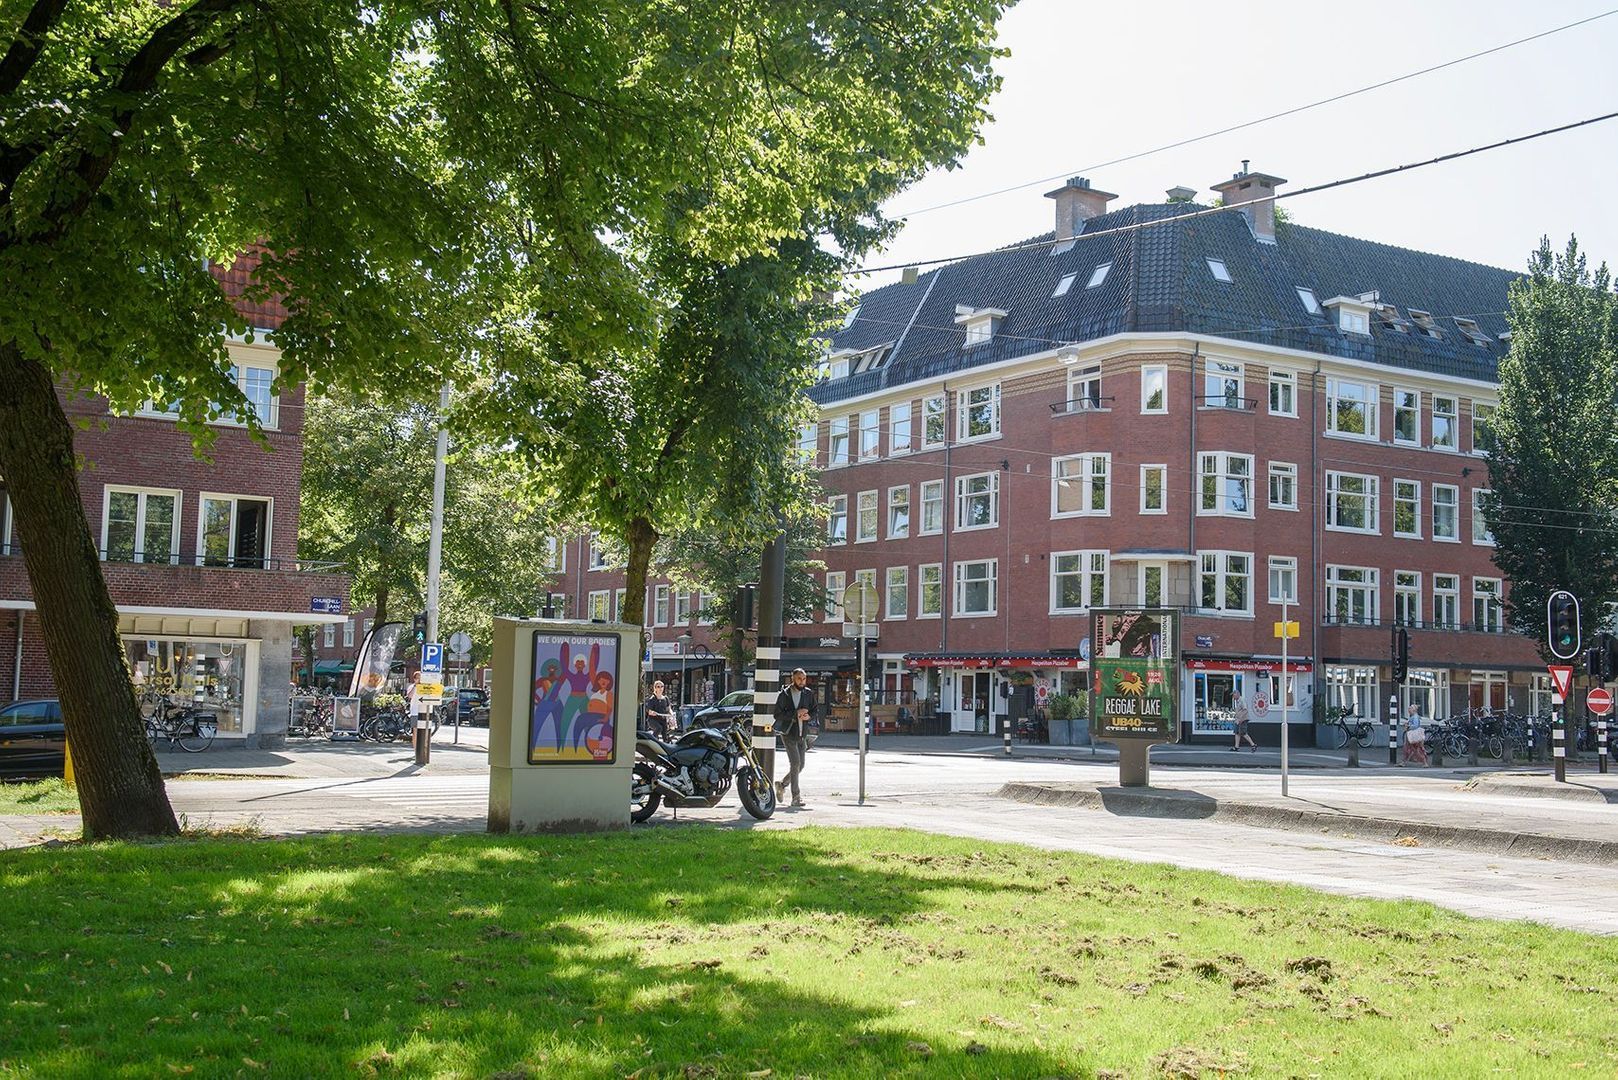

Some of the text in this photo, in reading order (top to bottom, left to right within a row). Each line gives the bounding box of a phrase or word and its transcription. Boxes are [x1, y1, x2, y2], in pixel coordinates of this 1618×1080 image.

[537, 636, 550, 644] WE
[551, 637, 569, 645] OWN
[588, 638, 616, 646] BODIES
[426, 646, 439, 661] P
[1105, 698, 1161, 716] REGGAE LAKE
[1112, 717, 1142, 727] UB40
